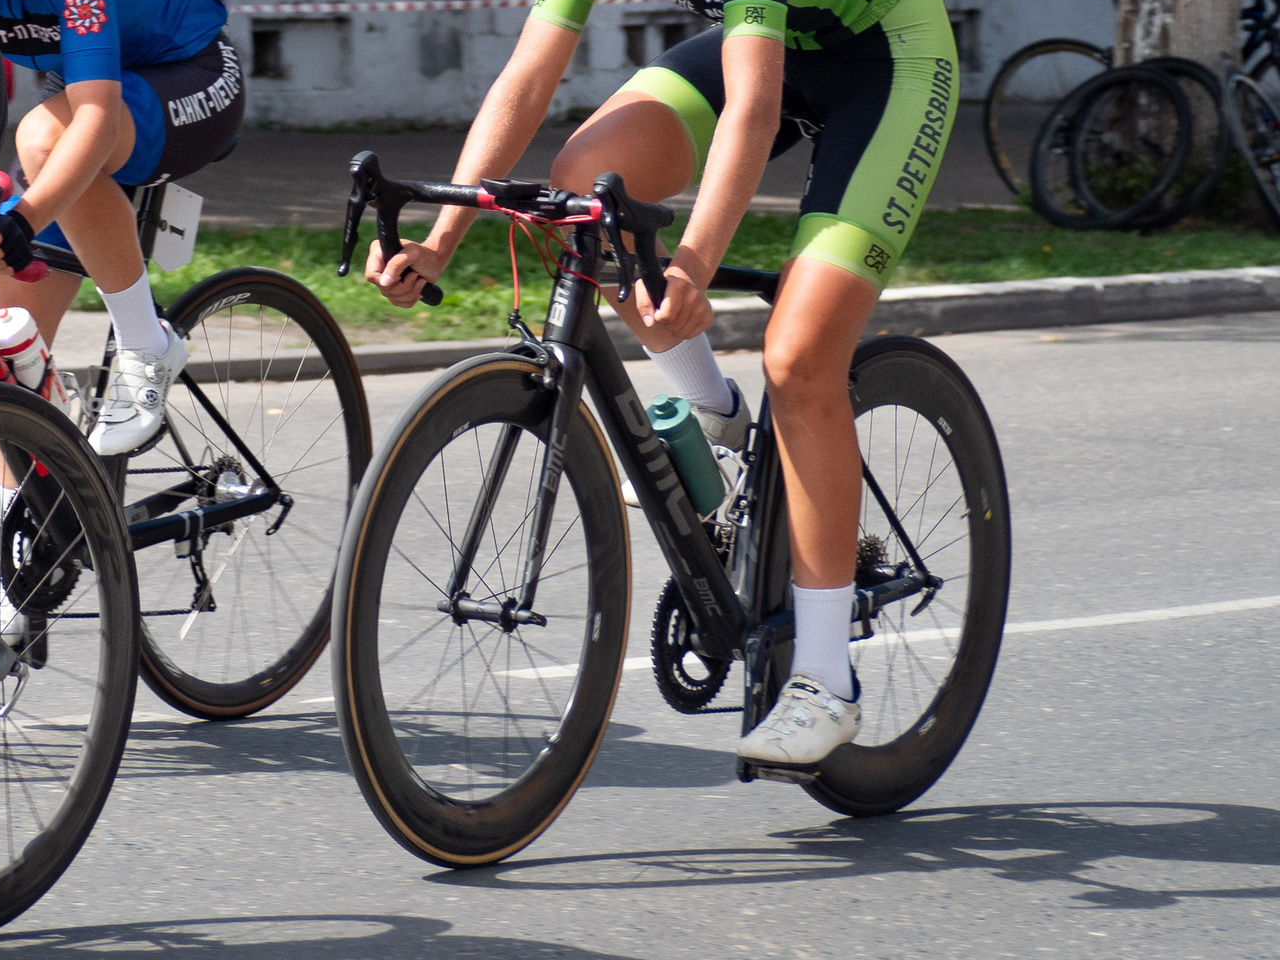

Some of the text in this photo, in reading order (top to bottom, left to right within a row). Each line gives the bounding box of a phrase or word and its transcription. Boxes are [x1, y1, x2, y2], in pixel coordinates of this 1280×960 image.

[744, 15, 766, 25] CAT
[745, 6, 766, 16] FAT
[864, 254, 888, 275] CAT
[870, 244, 892, 265] FAT
[542, 427, 568, 494] BMC
[693, 578, 723, 617] BMC
